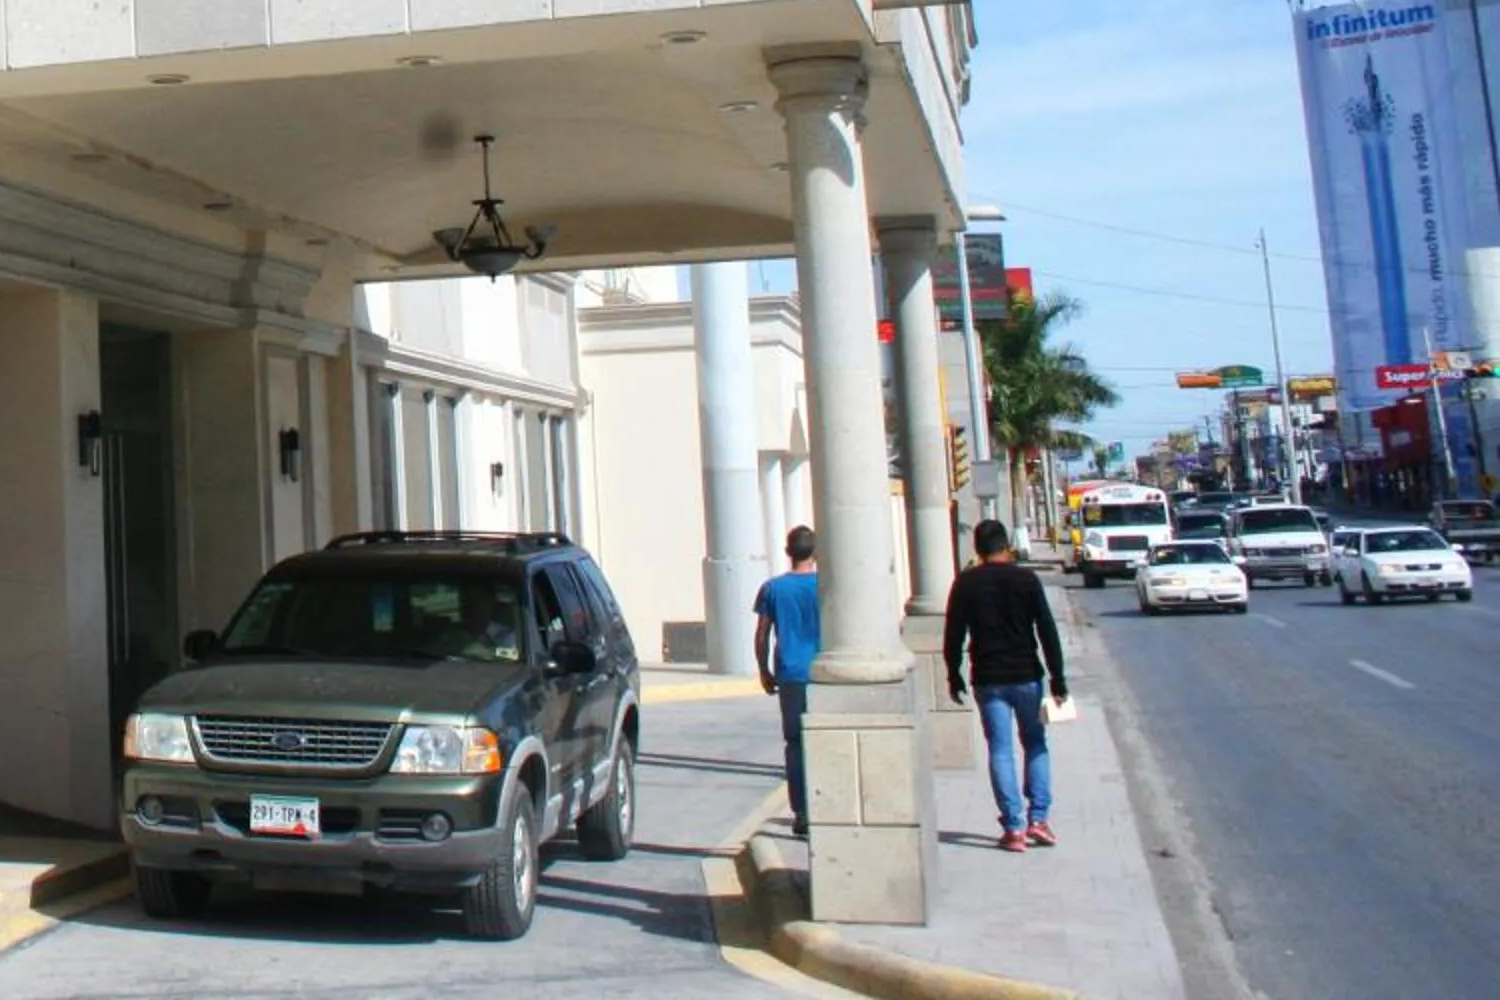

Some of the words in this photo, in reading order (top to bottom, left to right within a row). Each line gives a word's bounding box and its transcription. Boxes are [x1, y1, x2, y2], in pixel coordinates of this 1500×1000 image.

[1307, 2, 1434, 41] infinitum
[1409, 112, 1429, 171] rápido
[1423, 218, 1443, 281] mucho
